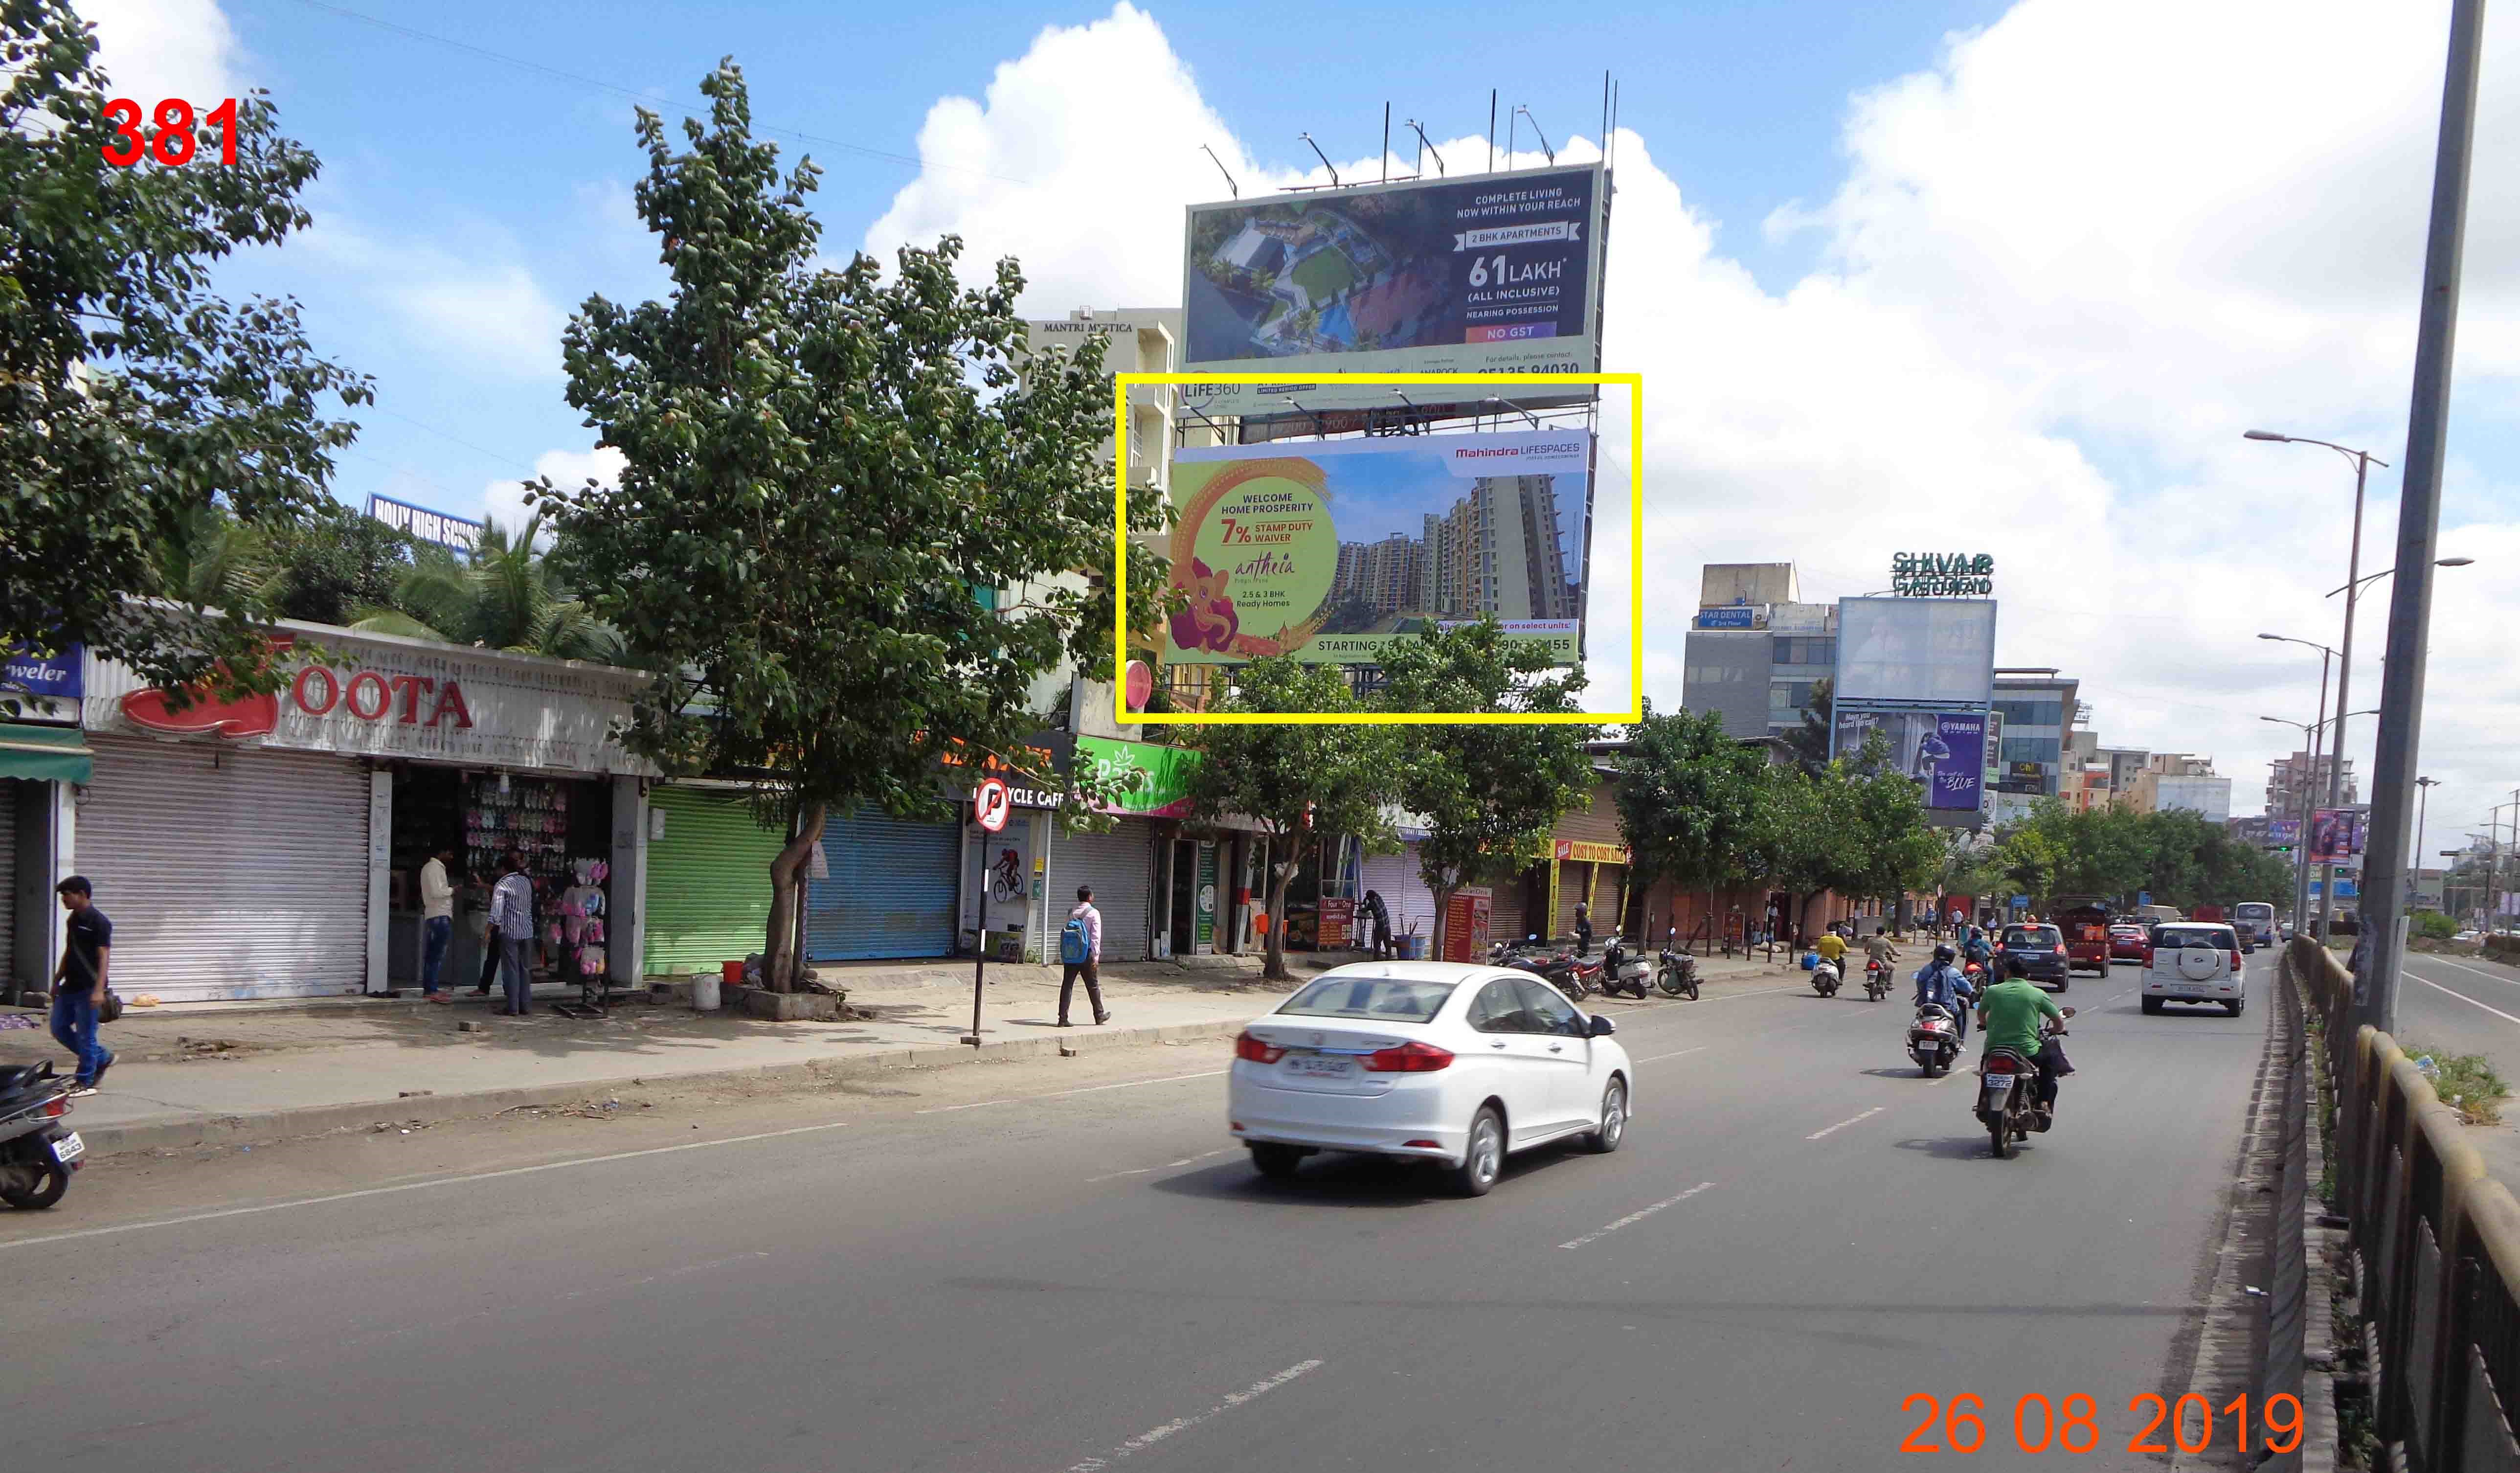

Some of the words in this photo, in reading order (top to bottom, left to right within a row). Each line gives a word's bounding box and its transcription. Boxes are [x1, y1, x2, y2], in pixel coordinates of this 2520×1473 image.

[1475, 191, 1527, 205] COMPLETE
[1530, 187, 1562, 200] LIVING
[1457, 207, 1479, 219] NOW
[1482, 204, 1516, 215] WITHIN
[1519, 201, 1545, 212] YOUR
[1548, 197, 1581, 209] REACH
[1472, 234, 1477, 243] 2
[1480, 232, 1498, 242] BHK
[1500, 226, 1561, 240] APARTMENTS
[1469, 254, 1506, 287] 61
[1468, 291, 1493, 303] (ALL
[1497, 286, 1560, 299] INCLUSIVE)
[1467, 309, 1504, 319] NEARING
[1506, 305, 1559, 316] POSSESSION
[1044, 323, 1084, 333] MANTRI
[1487, 328, 1506, 340] NO
[1510, 326, 1535, 337] GST
[1521, 443, 1580, 454] LIFESPACES
[1243, 493, 1293, 503] WELCOME
[1221, 505, 1251, 514] HOME
[1253, 503, 1314, 514] PROSPERITY
[375, 498, 411, 532] HOLLY
[412, 509, 442, 542] HIGH
[442, 518, 486, 550] SCHOO
[1255, 523, 1287, 532] STAMP
[1288, 522, 1313, 531] DUTY
[1221, 519, 1251, 544] 7%
[1255, 534, 1291, 542] WAIVER
[1235, 550, 1296, 580] antheia
[1892, 551, 1995, 574] SHIVAR
[1237, 600, 1261, 611] Ready
[1721, 611, 1751, 619] DENTAL
[1318, 640, 1377, 651] STARTING
[5, 662, 67, 681] weler
[1950, 723, 1980, 731] YAMAHA
[1945, 777, 1976, 791] BLUE
[1557, 841, 1570, 857] SALE
[1573, 844, 1588, 859] COST
[1589, 845, 1596, 859] TO
[1597, 846, 1611, 861] COST
